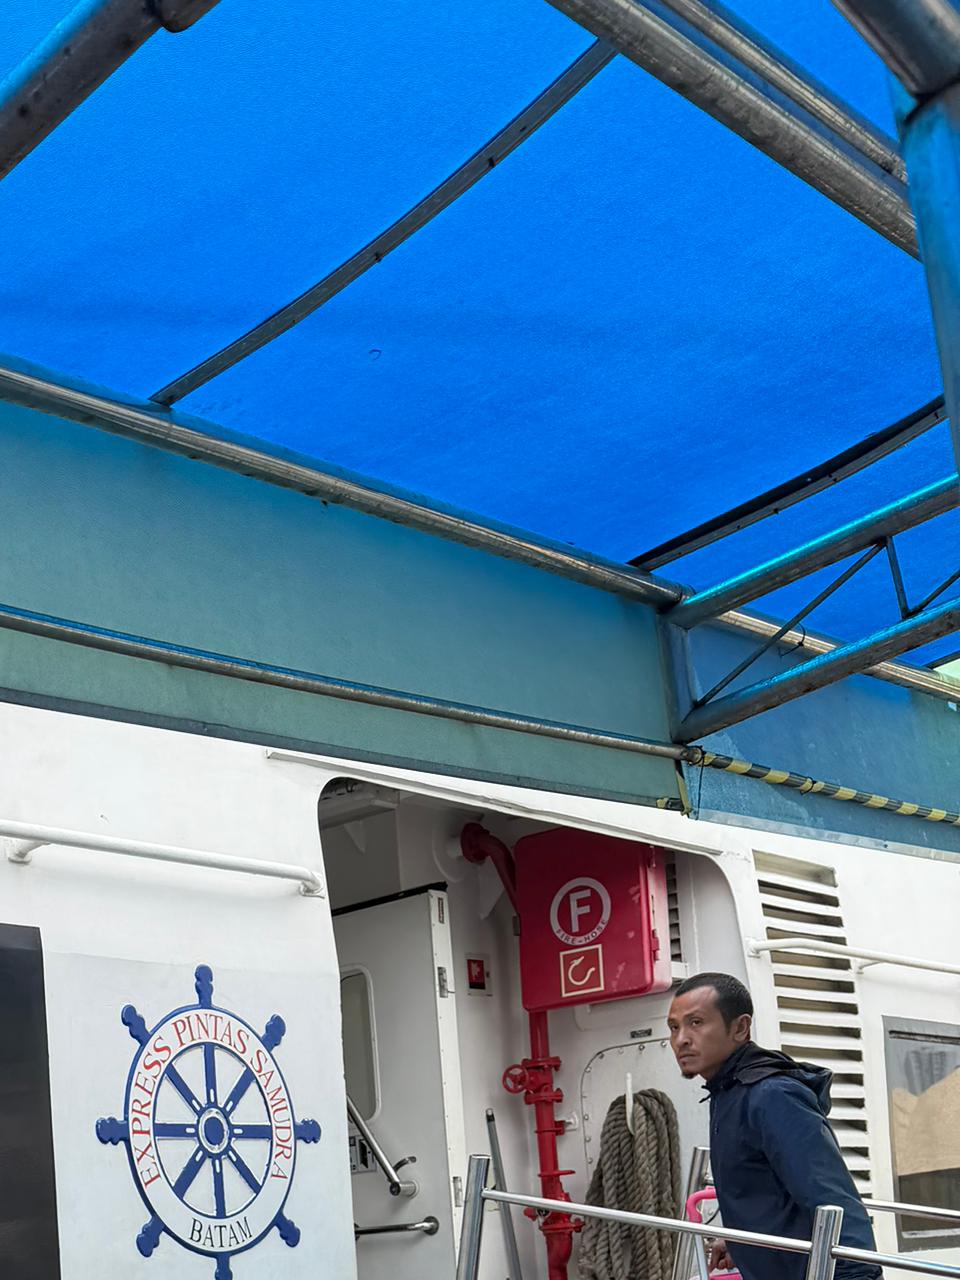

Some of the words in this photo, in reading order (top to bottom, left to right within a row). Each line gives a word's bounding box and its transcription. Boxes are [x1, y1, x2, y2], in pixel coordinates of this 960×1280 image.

[131, 1035, 172, 1189] EXPRESS
[172, 1013, 250, 1055] PINTAS
[250, 1049, 293, 1180] SAMUDRA
[189, 1216, 253, 1248] BATAM
